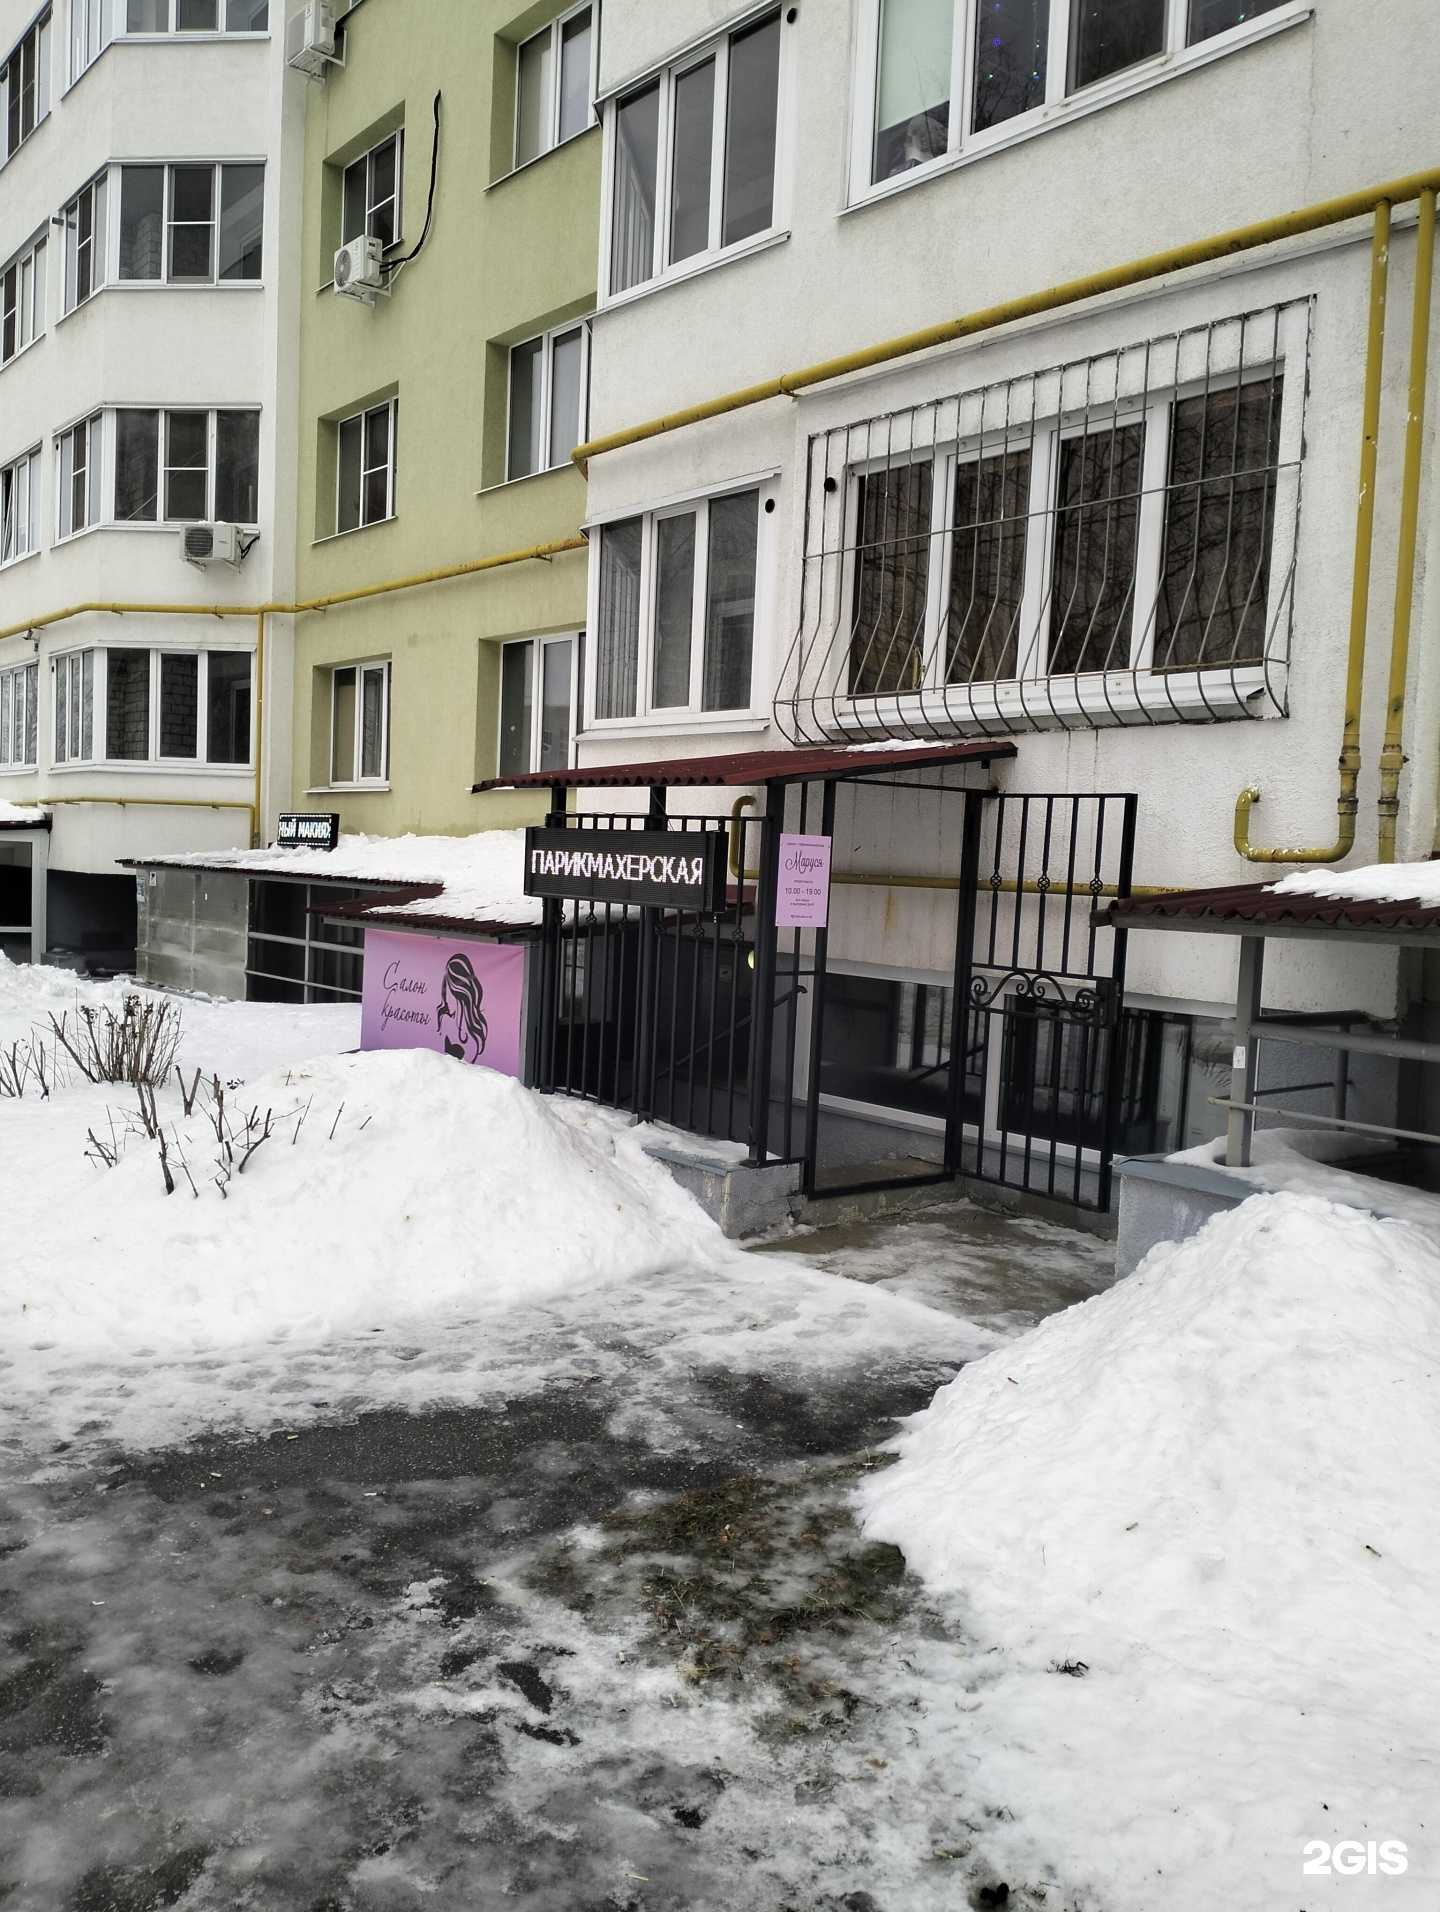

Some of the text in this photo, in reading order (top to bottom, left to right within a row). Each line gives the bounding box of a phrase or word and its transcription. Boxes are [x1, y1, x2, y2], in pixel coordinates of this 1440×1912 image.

[531, 850, 703, 885] ПАРИКМАХЕРСКАЯ
[785, 850, 824, 874] Маруся
[384, 960, 427, 994] Салон
